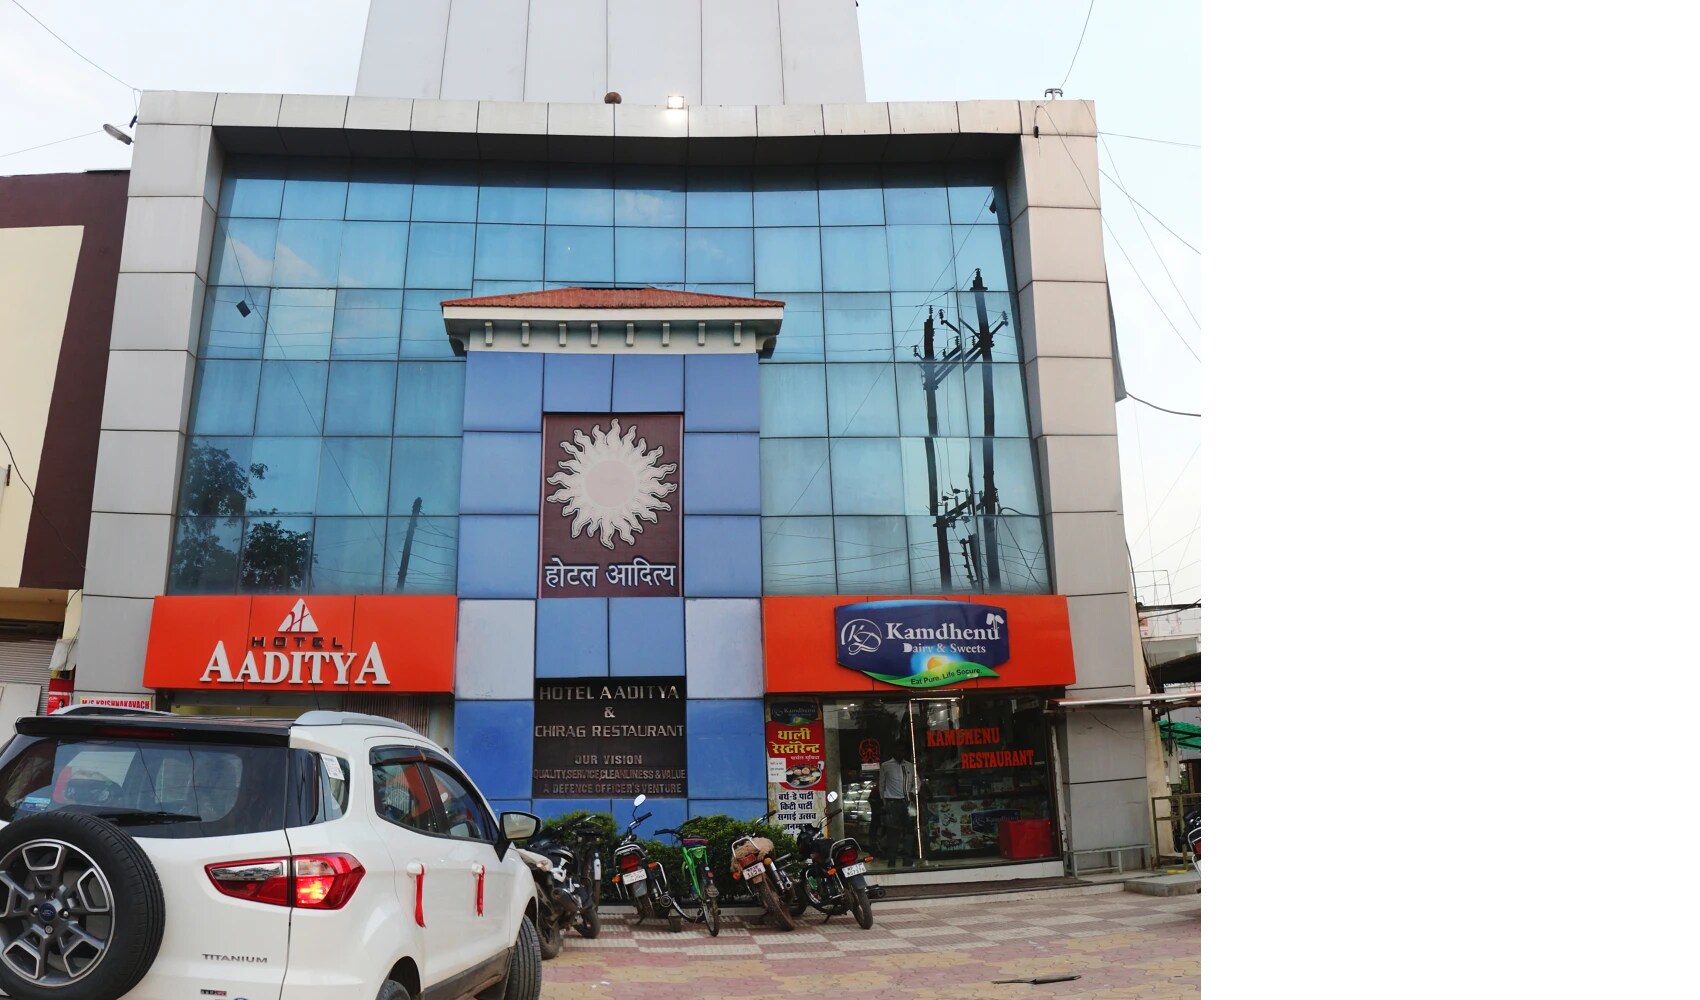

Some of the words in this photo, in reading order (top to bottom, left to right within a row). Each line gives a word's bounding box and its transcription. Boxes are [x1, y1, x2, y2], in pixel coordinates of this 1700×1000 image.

[544, 557, 599, 588] होटल
[605, 557, 677, 587] आदित्य
[885, 622, 1001, 641] Kamdhenu
[252, 636, 343, 648] HOTEL
[937, 643, 946, 654] &
[950, 643, 986, 654] Sweets
[910, 677, 923, 685] Eat
[923, 675, 941, 684] Pure.
[942, 671, 955, 680] Life
[539, 686, 594, 700] HOTEL
[599, 685, 680, 700] AADITYA
[604, 706, 616, 718] &
[534, 725, 587, 737] CHIRAG
[592, 724, 684, 737] RESTAURANT
[777, 727, 811, 740] थाली
[927, 727, 1001, 747] KAMDHENU
[603, 754, 643, 765] VISION
[961, 749, 1035, 769] RESTAURANT
[552, 783, 593, 793] DEFENCE
[642, 783, 682, 793] VENTURE
[799, 791, 814, 800] पार्टी
[798, 801, 813, 810] पार्टी
[777, 812, 797, 821] सगाई
[202, 953, 268, 963] TITANIUM
